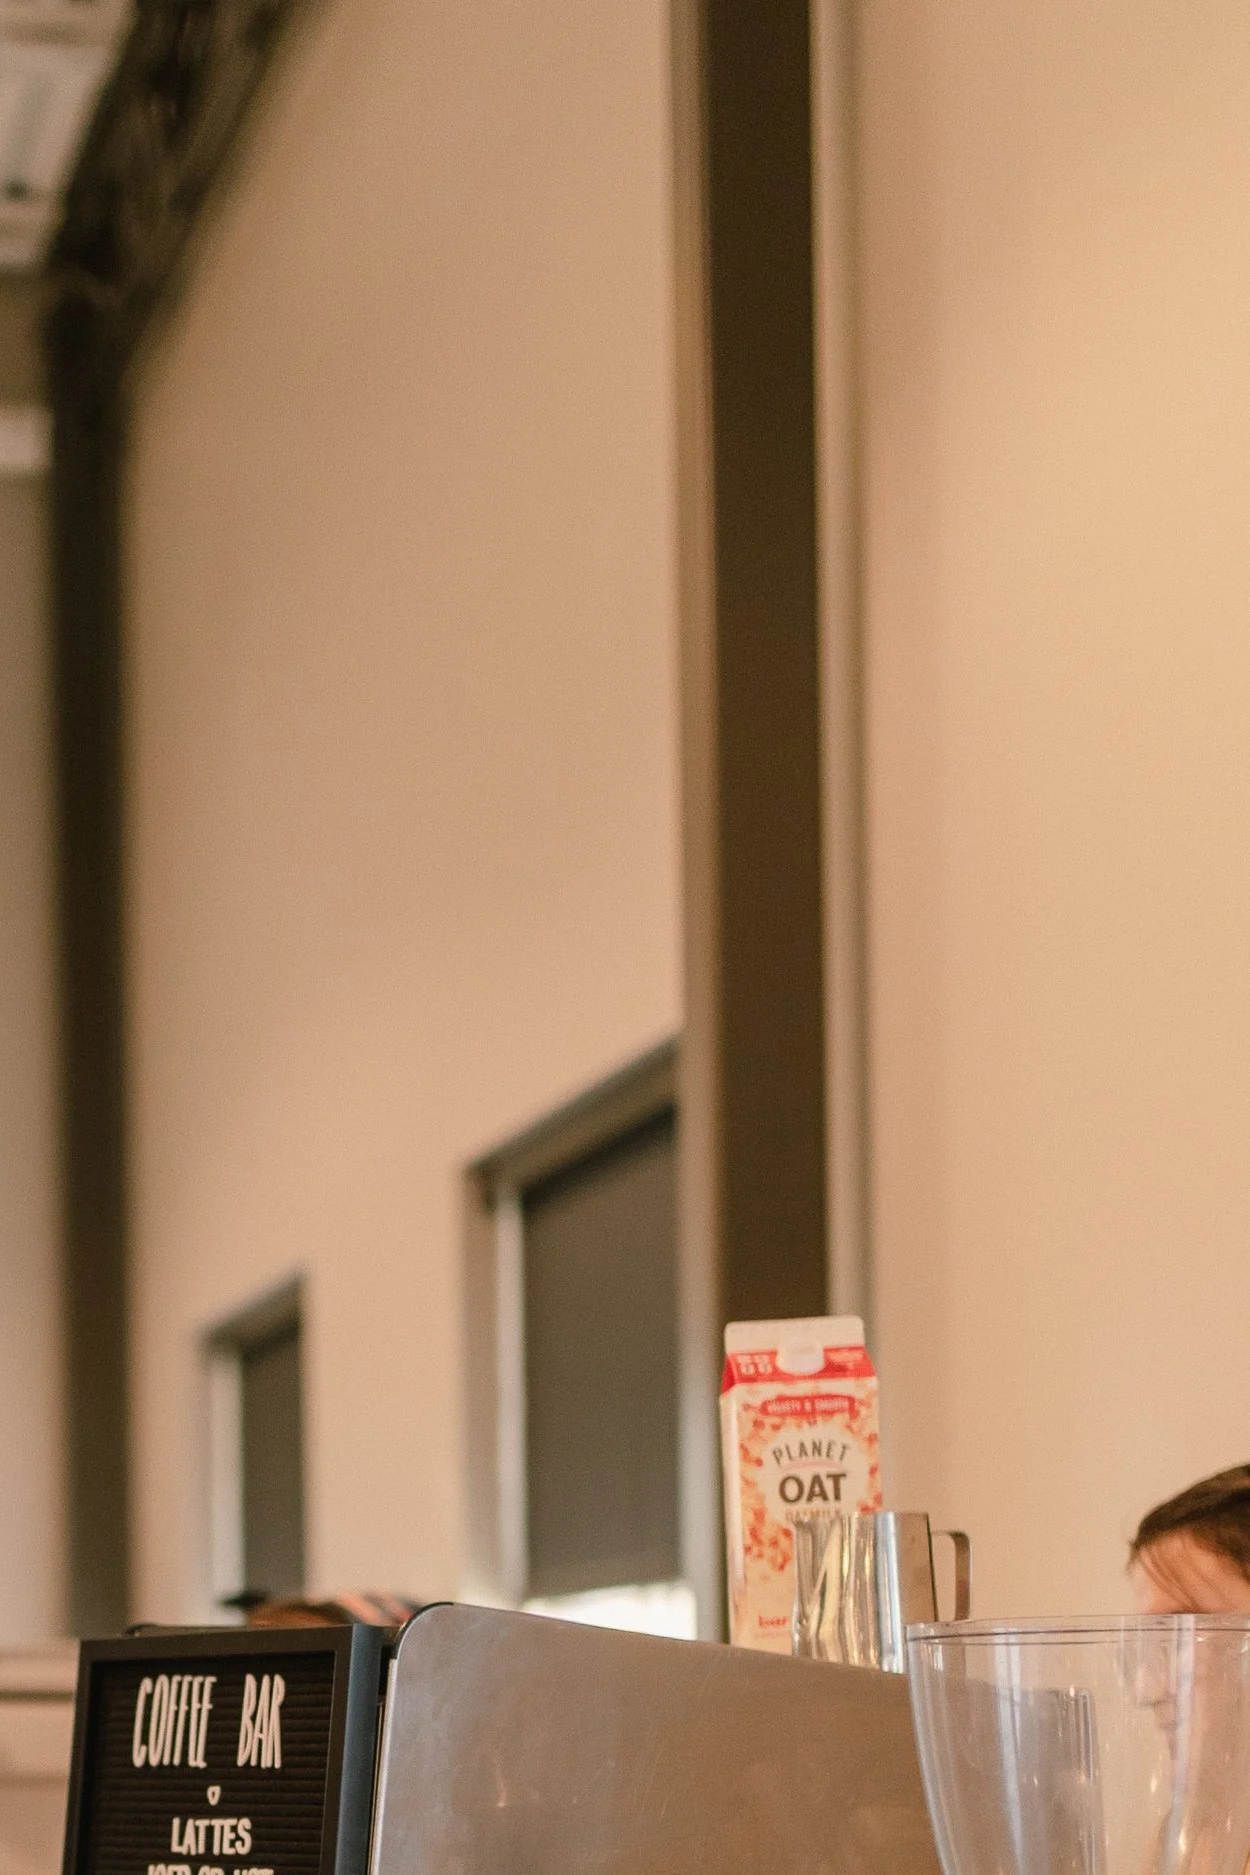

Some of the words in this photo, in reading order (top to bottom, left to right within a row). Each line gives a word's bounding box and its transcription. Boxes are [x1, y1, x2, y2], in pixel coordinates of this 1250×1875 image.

[772, 1437, 852, 1465] PLANET
[778, 1473, 848, 1504] OAT
[132, 1673, 217, 1768] COFFEE
[236, 1673, 286, 1769] BAR
[170, 1816, 252, 1856] LATTES
